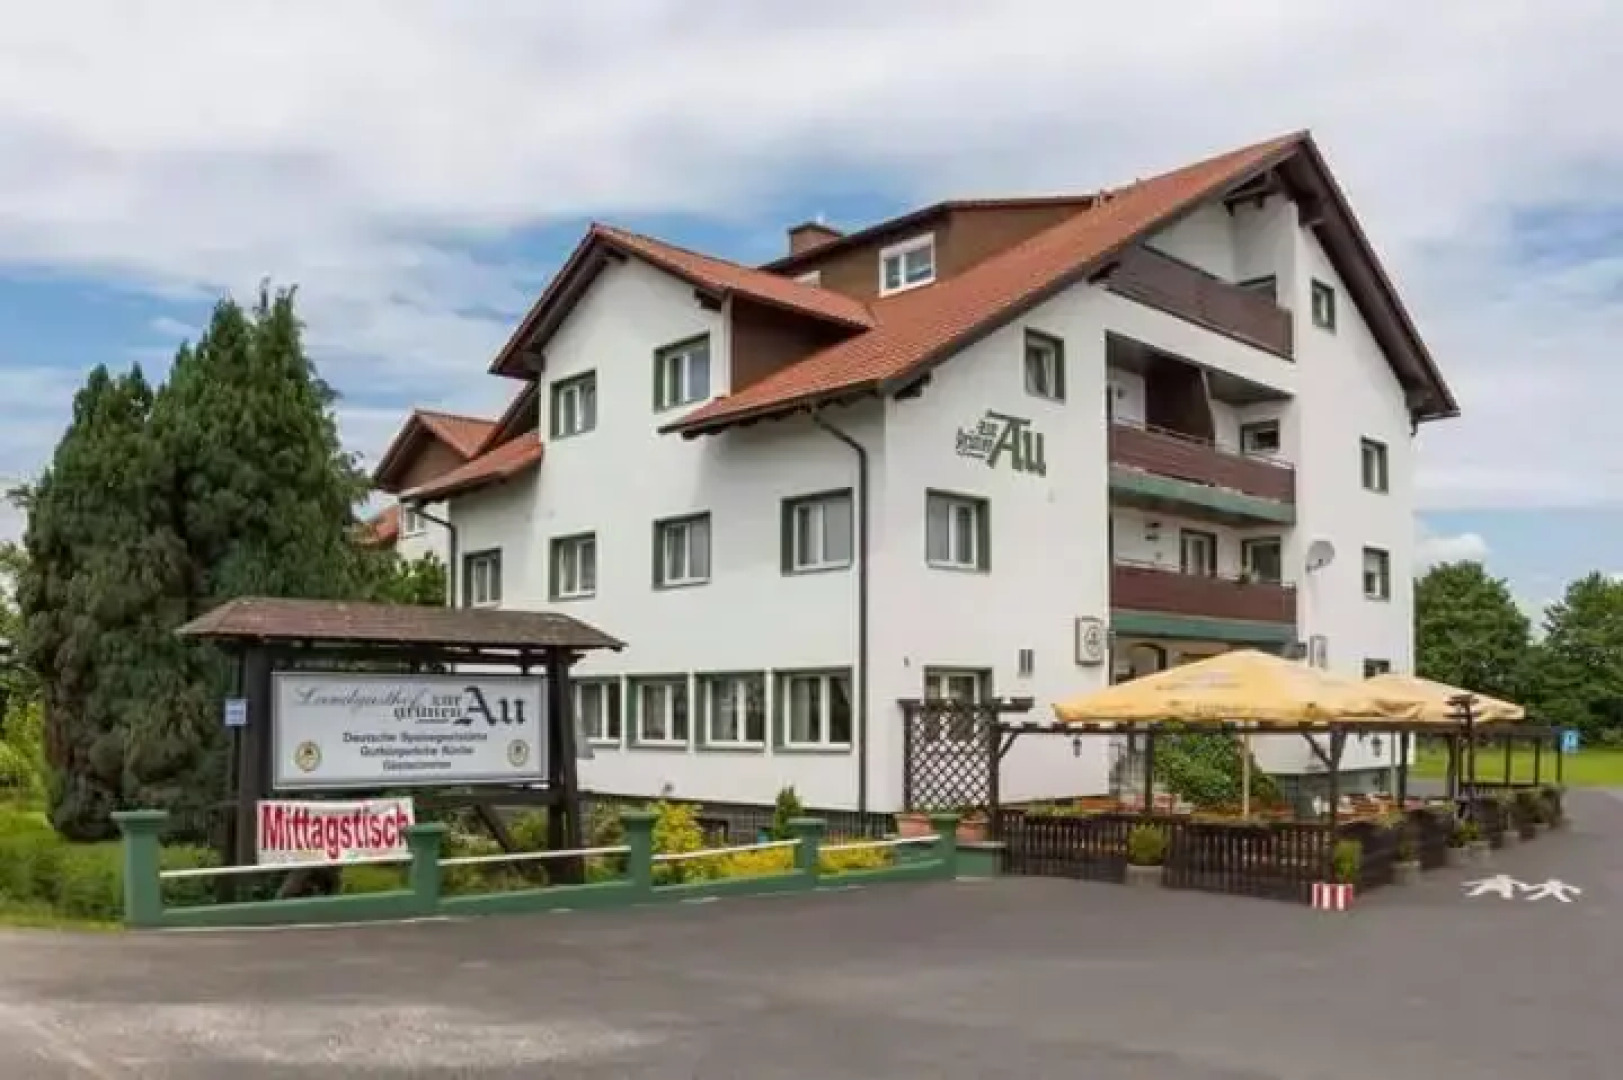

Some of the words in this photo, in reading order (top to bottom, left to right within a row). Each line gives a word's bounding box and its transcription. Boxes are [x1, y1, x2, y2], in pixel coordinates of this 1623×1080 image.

[985, 408, 1047, 478] Au
[454, 685, 526, 725] Au
[263, 803, 409, 860] Mittagstisch
